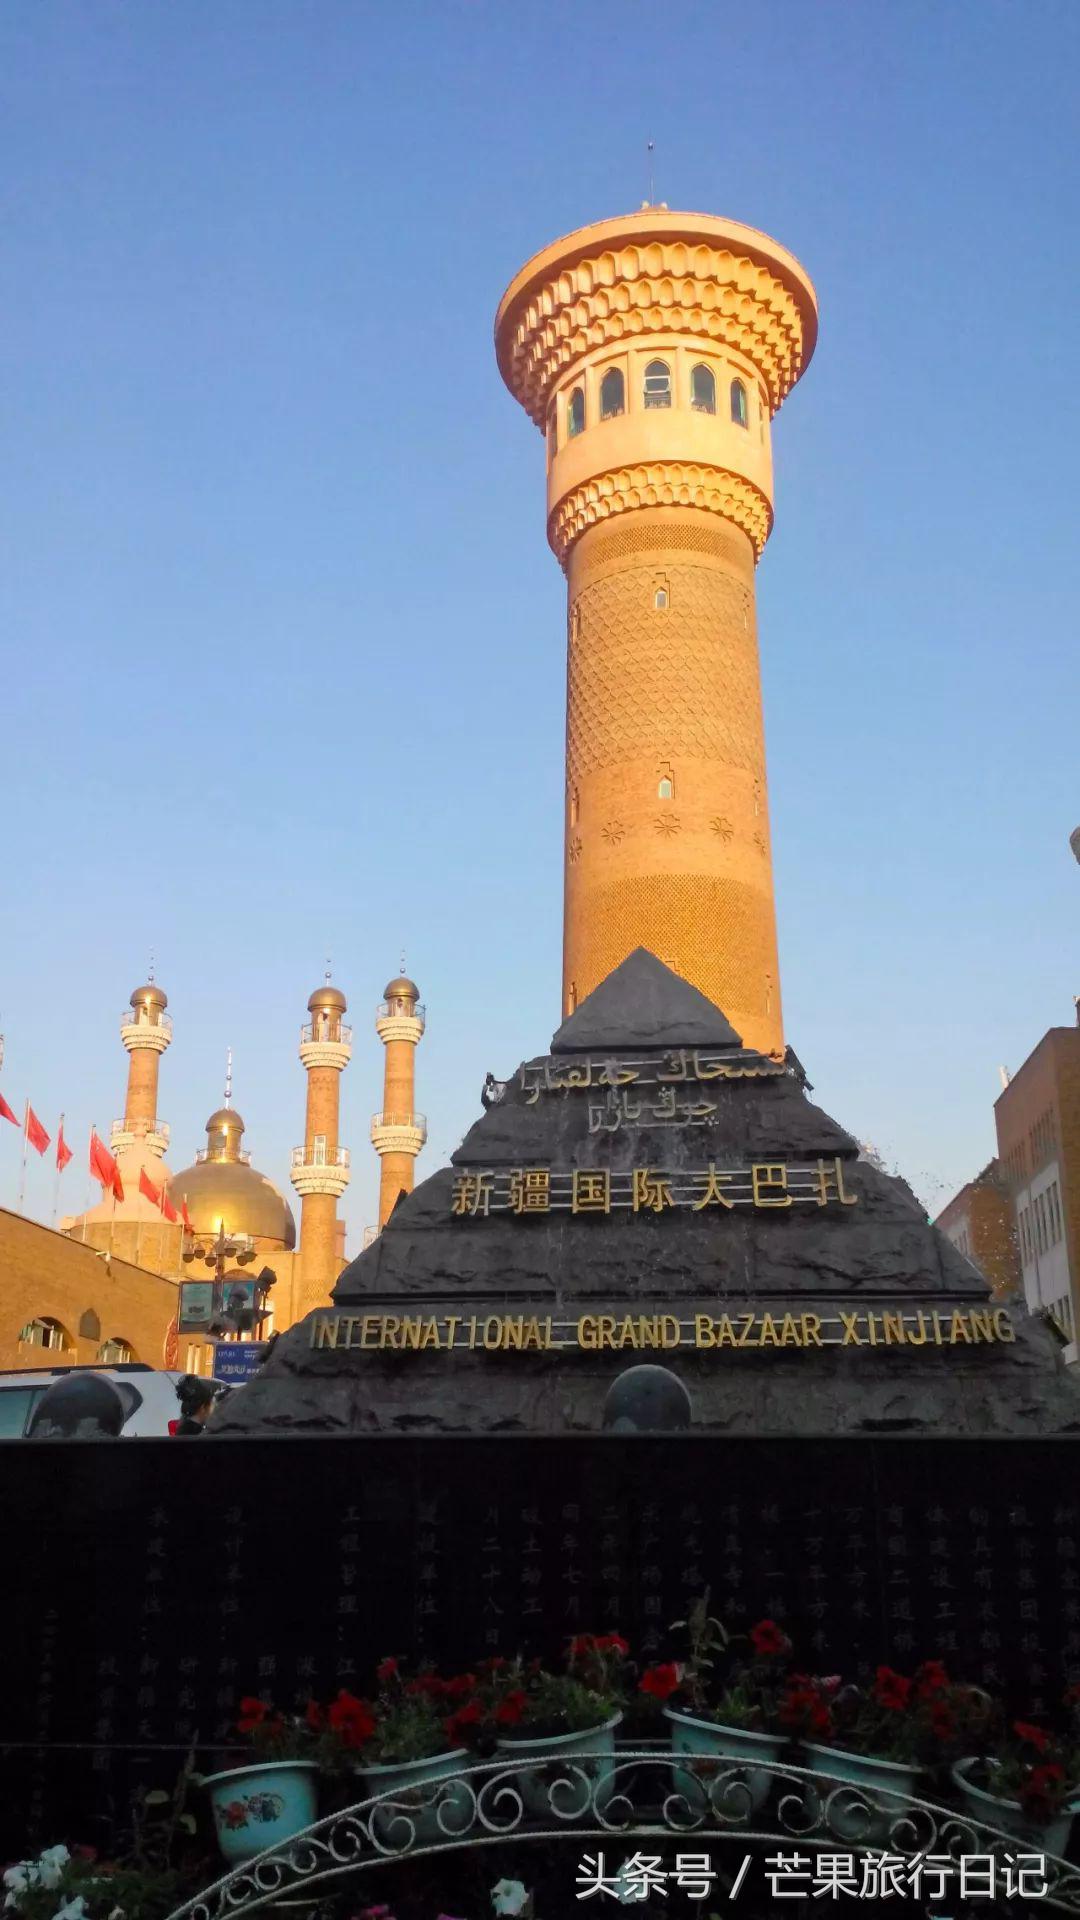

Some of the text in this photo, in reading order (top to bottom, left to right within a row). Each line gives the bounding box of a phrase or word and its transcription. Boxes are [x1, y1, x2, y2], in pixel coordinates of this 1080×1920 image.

[451, 1156, 858, 1216] 新疆国际大巴扎
[310, 1308, 1016, 1350] INTERNATIONAL GRAND BAZAAR XINJIANG
